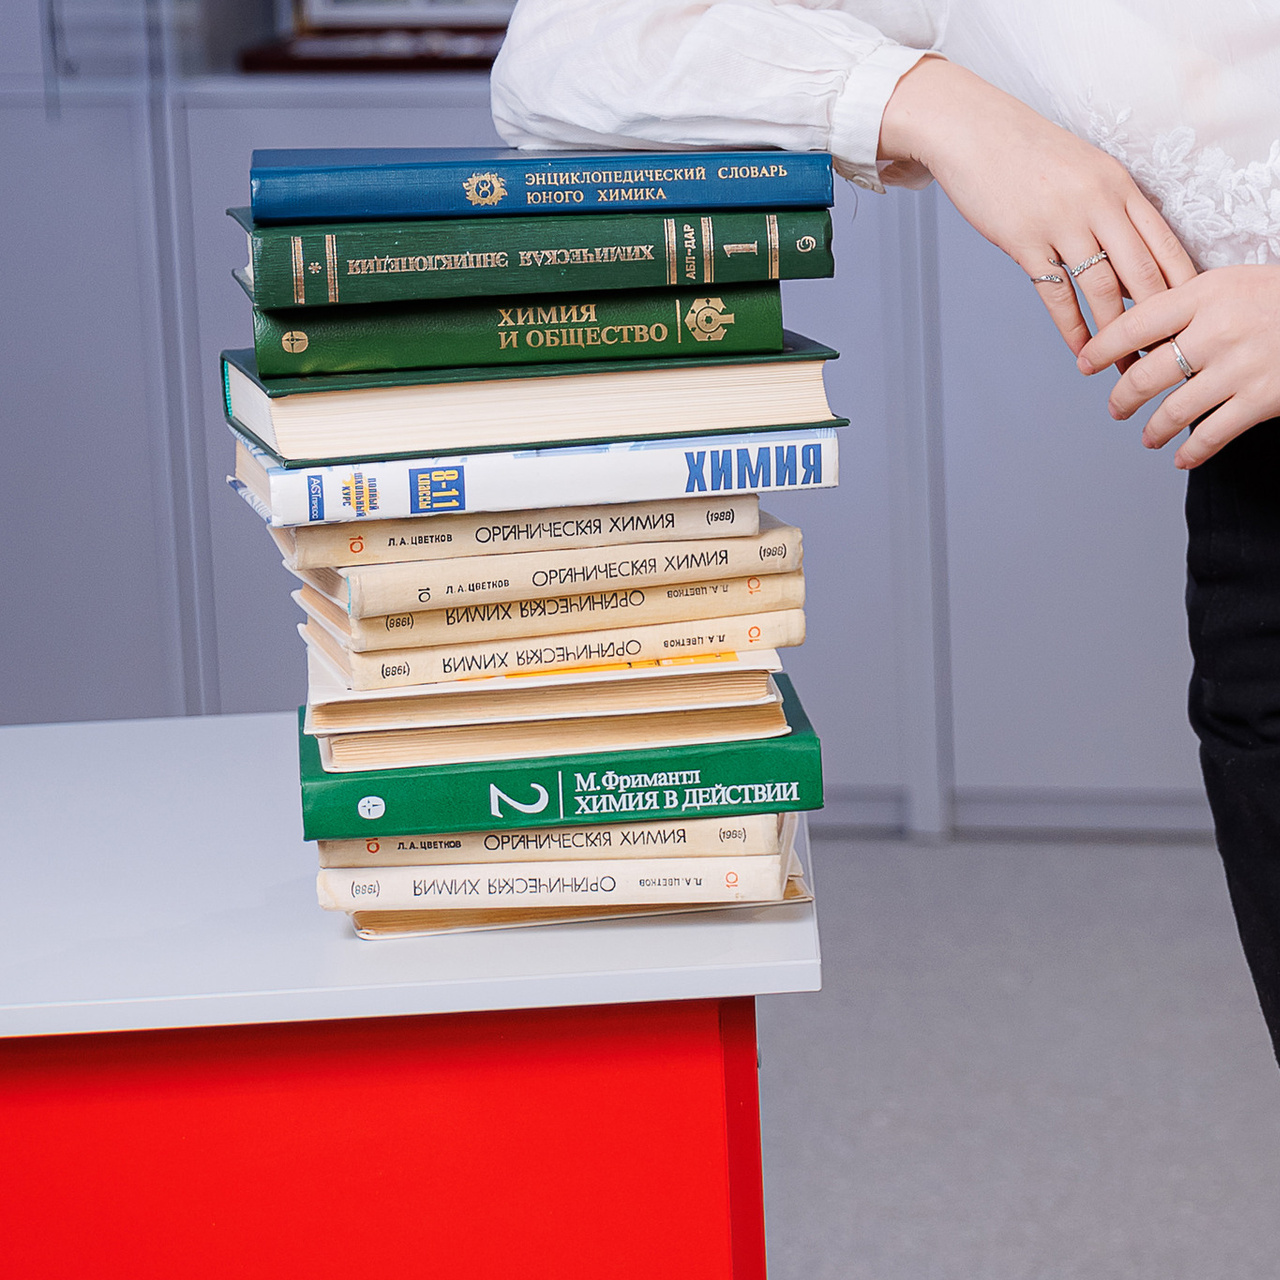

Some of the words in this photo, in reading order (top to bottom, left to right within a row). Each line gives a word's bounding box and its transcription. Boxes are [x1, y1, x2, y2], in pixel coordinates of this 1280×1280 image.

[525, 166, 706, 186] ЭНЦИКЛОПЕДИЧЕСКИЙ
[717, 165, 788, 180] СЛОВАРЬ
[526, 189, 585, 205] ЮНОГО
[597, 187, 667, 203] ХИМИКА
[518, 244, 655, 267] ХИМИЧЕСКАЯ
[722, 240, 758, 258] 1
[346, 251, 509, 275] ЭНЦИКЛОПЕДИЯ
[497, 303, 598, 327] ХИМИЯ
[498, 330, 519, 349] И
[525, 322, 669, 349] ОБЩЕСТВО
[684, 443, 822, 493] ХИМИЯ
[431, 469, 460, 509] 8-11
[475, 516, 602, 544] ОРГАНИЧЕСКАЯ
[609, 512, 676, 533] ХИМИЯ
[705, 508, 735, 525] (1988)
[531, 557, 657, 587] ОРГАНИЧЕСКАЯ
[664, 549, 729, 571] ХИМИЯ
[758, 543, 788, 560] (1988)
[445, 602, 512, 626] ХИМИЯ
[519, 589, 645, 619] ОРГАНИЧЕСКАЯ
[384, 612, 414, 631] (1988)
[442, 651, 509, 674] ХИМИЯ
[516, 639, 642, 667] ОРГАНИЧЕСКАЯ
[381, 661, 411, 679] (1988)
[488, 782, 550, 818] 2
[574, 790, 660, 815] ХИМИЯ
[664, 790, 679, 810] В
[681, 781, 801, 812] ДЕЙСТВИИ
[483, 831, 612, 852] ОРГАНИЧЕСКАЯ
[620, 828, 687, 847] ХИМИЯ
[350, 879, 381, 899] (1988)
[412, 878, 481, 897] ХИМИЯ
[487, 875, 616, 896] ОРГАНИЧЕСКАЯ
